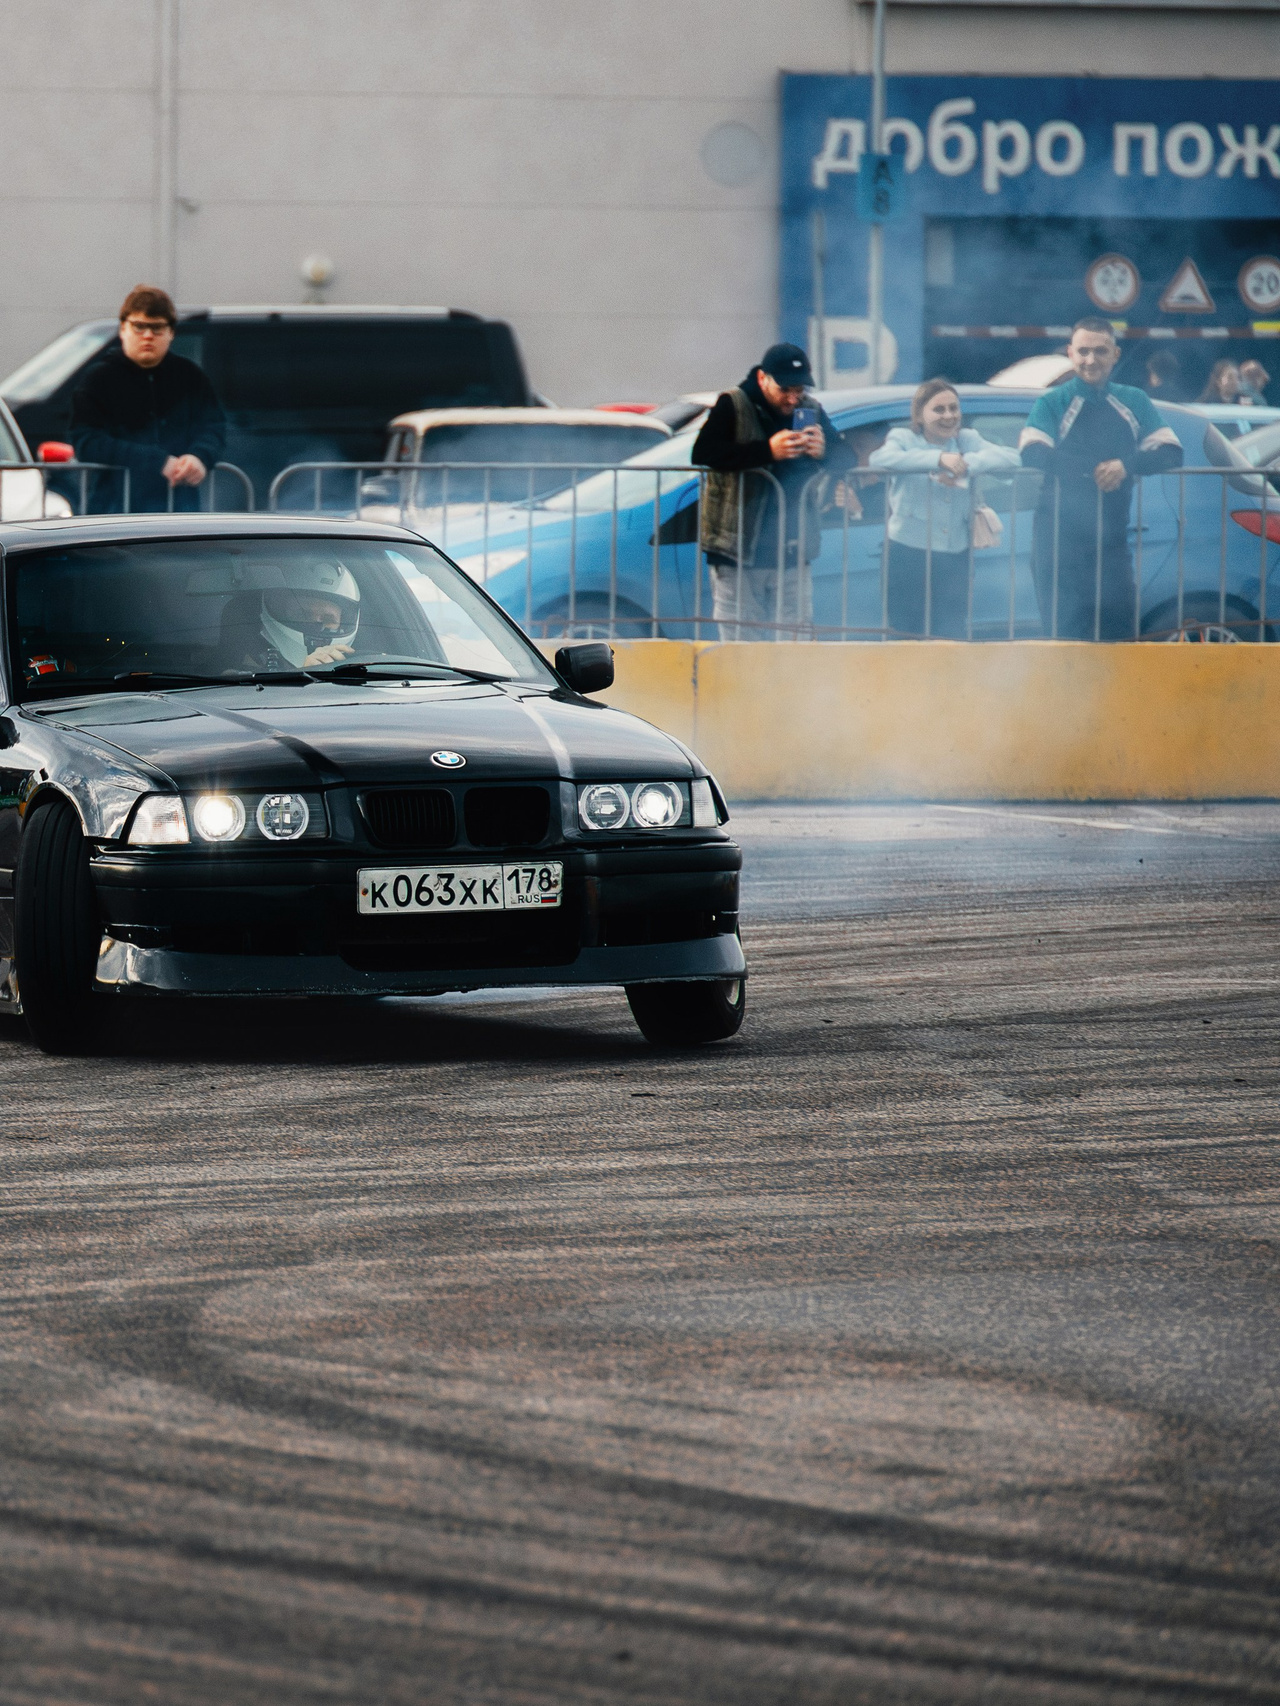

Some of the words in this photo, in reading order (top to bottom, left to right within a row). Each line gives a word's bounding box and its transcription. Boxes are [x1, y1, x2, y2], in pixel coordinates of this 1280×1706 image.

[813, 98, 1085, 194] добро
[1113, 121, 1280, 179] пож
[507, 867, 552, 894] 178
[517, 894, 541, 904] RUS
